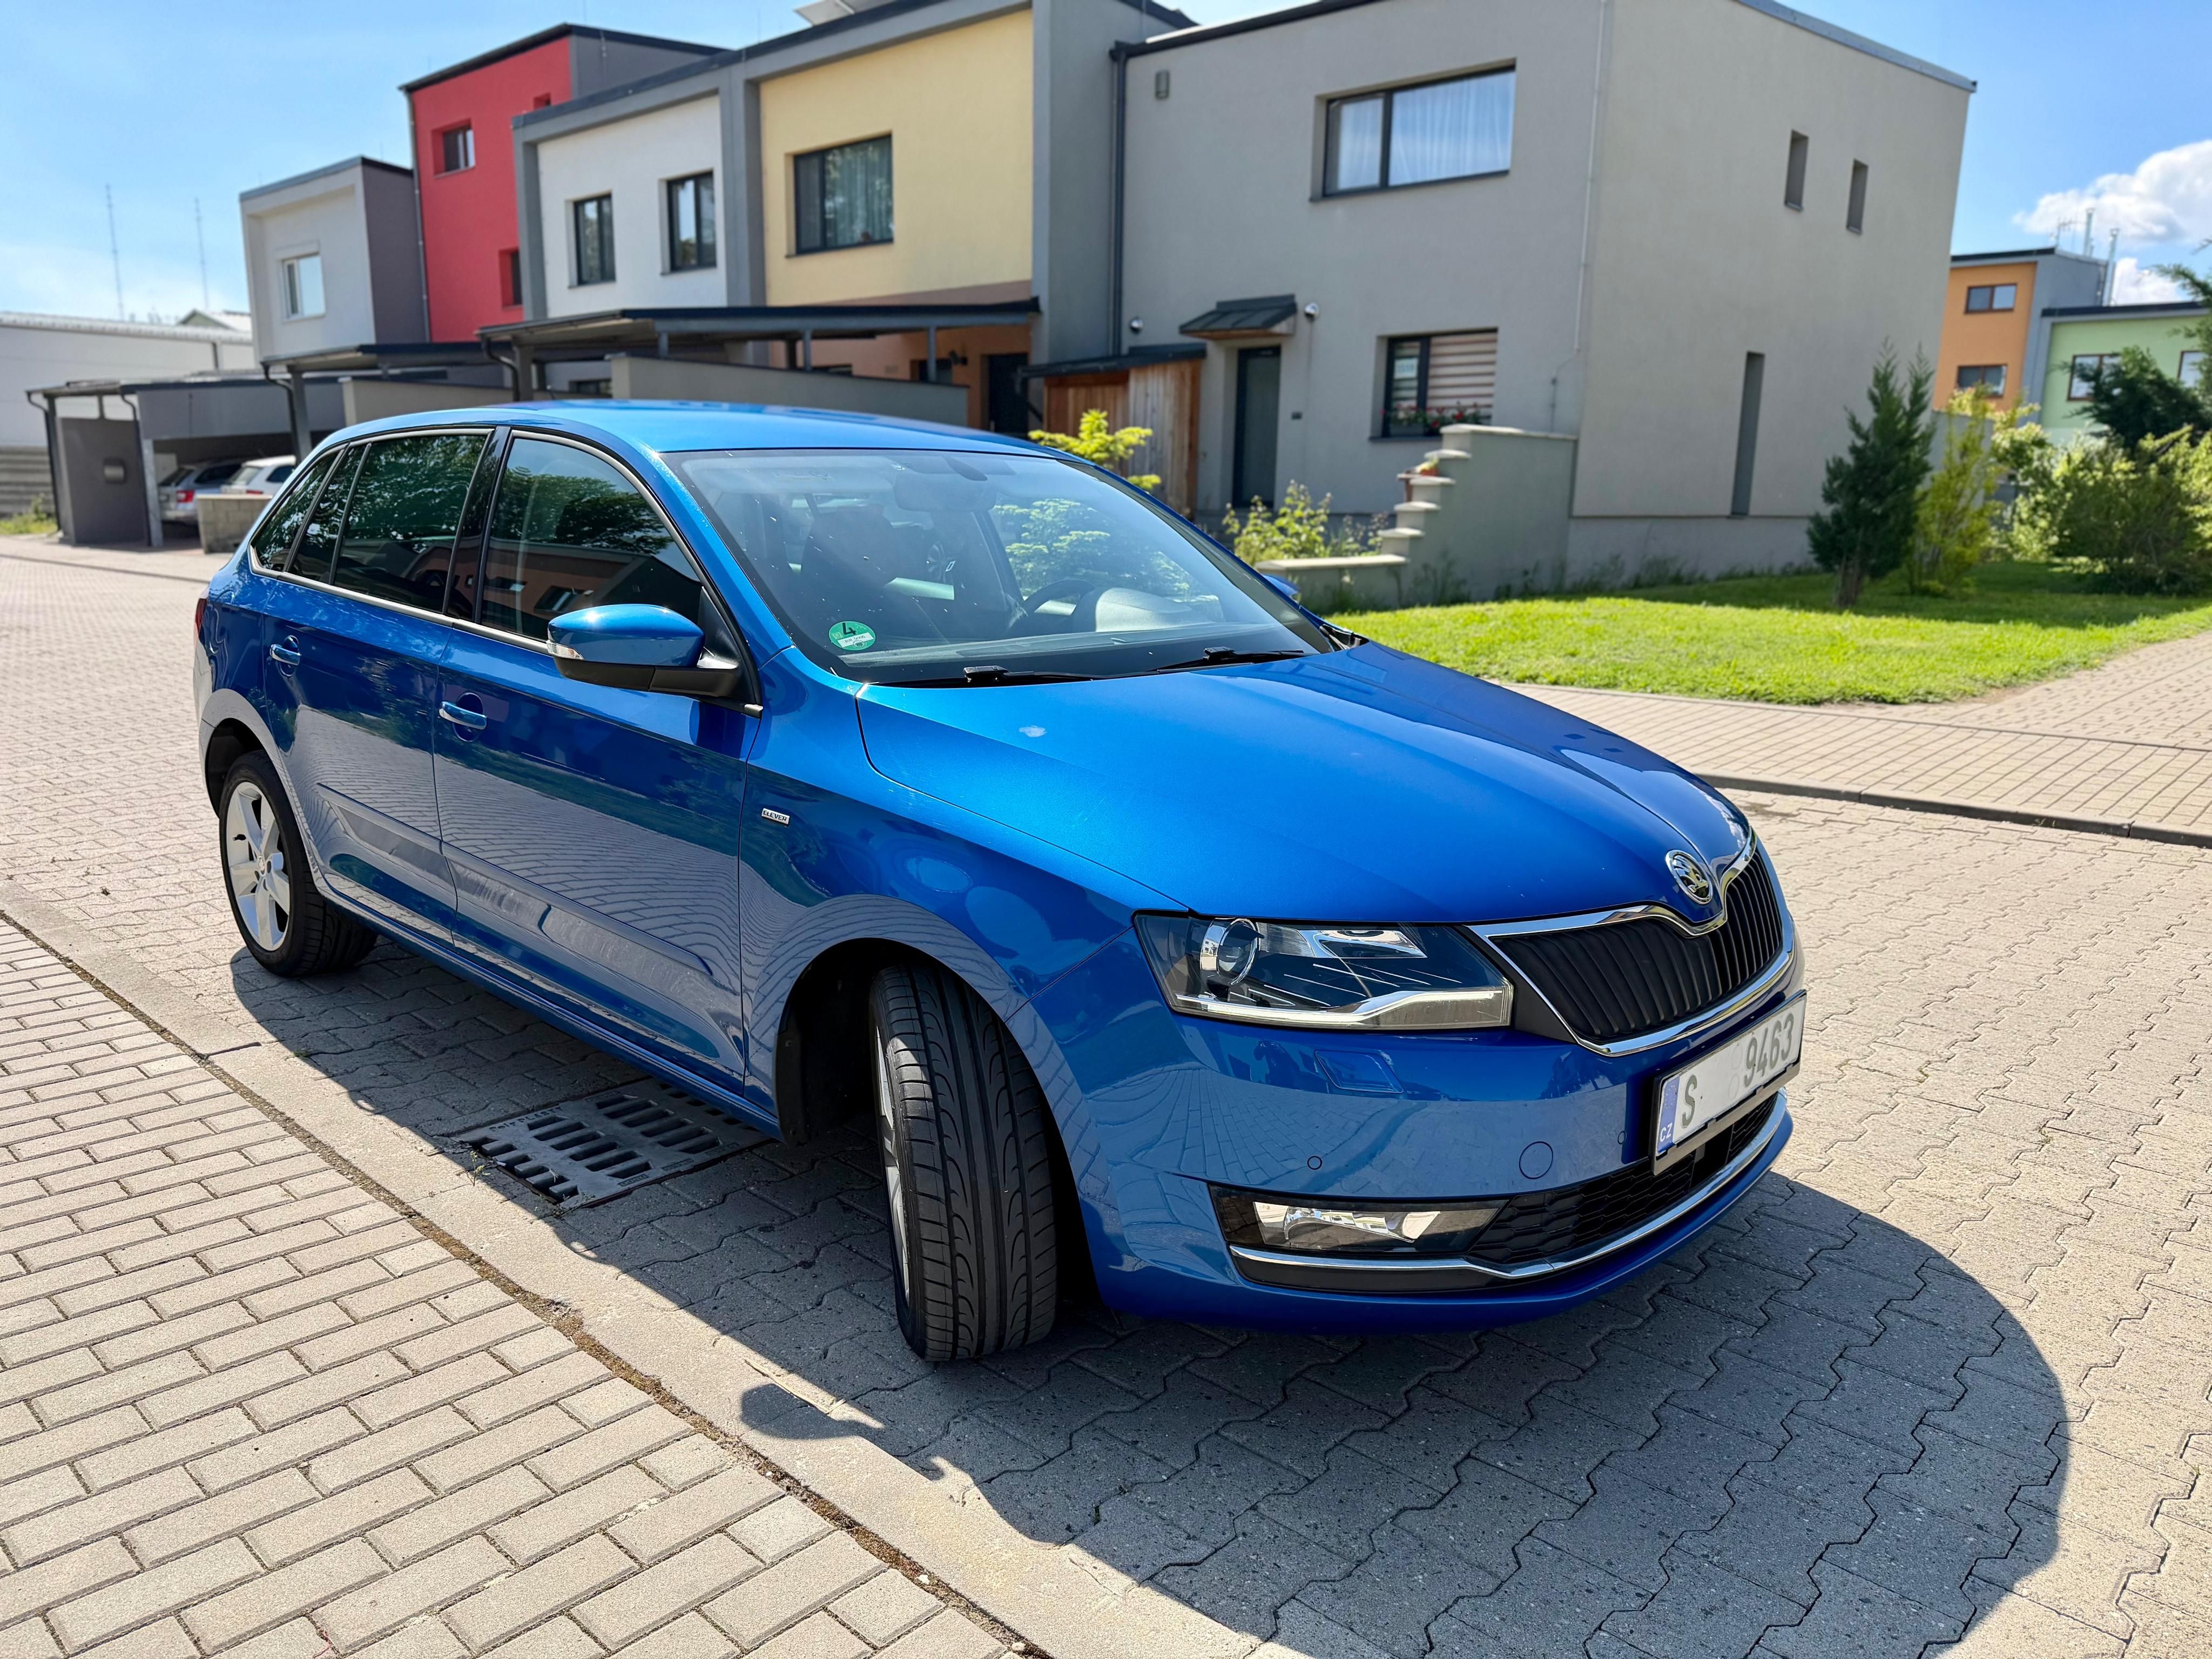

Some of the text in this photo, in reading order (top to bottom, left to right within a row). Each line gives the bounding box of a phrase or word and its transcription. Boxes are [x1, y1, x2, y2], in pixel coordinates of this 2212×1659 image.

[842, 623, 857, 635] 4
[763, 810, 787, 821] CLEVER
[1681, 1013, 1795, 1129] S 9463
[1660, 1122, 1673, 1143] CZ
